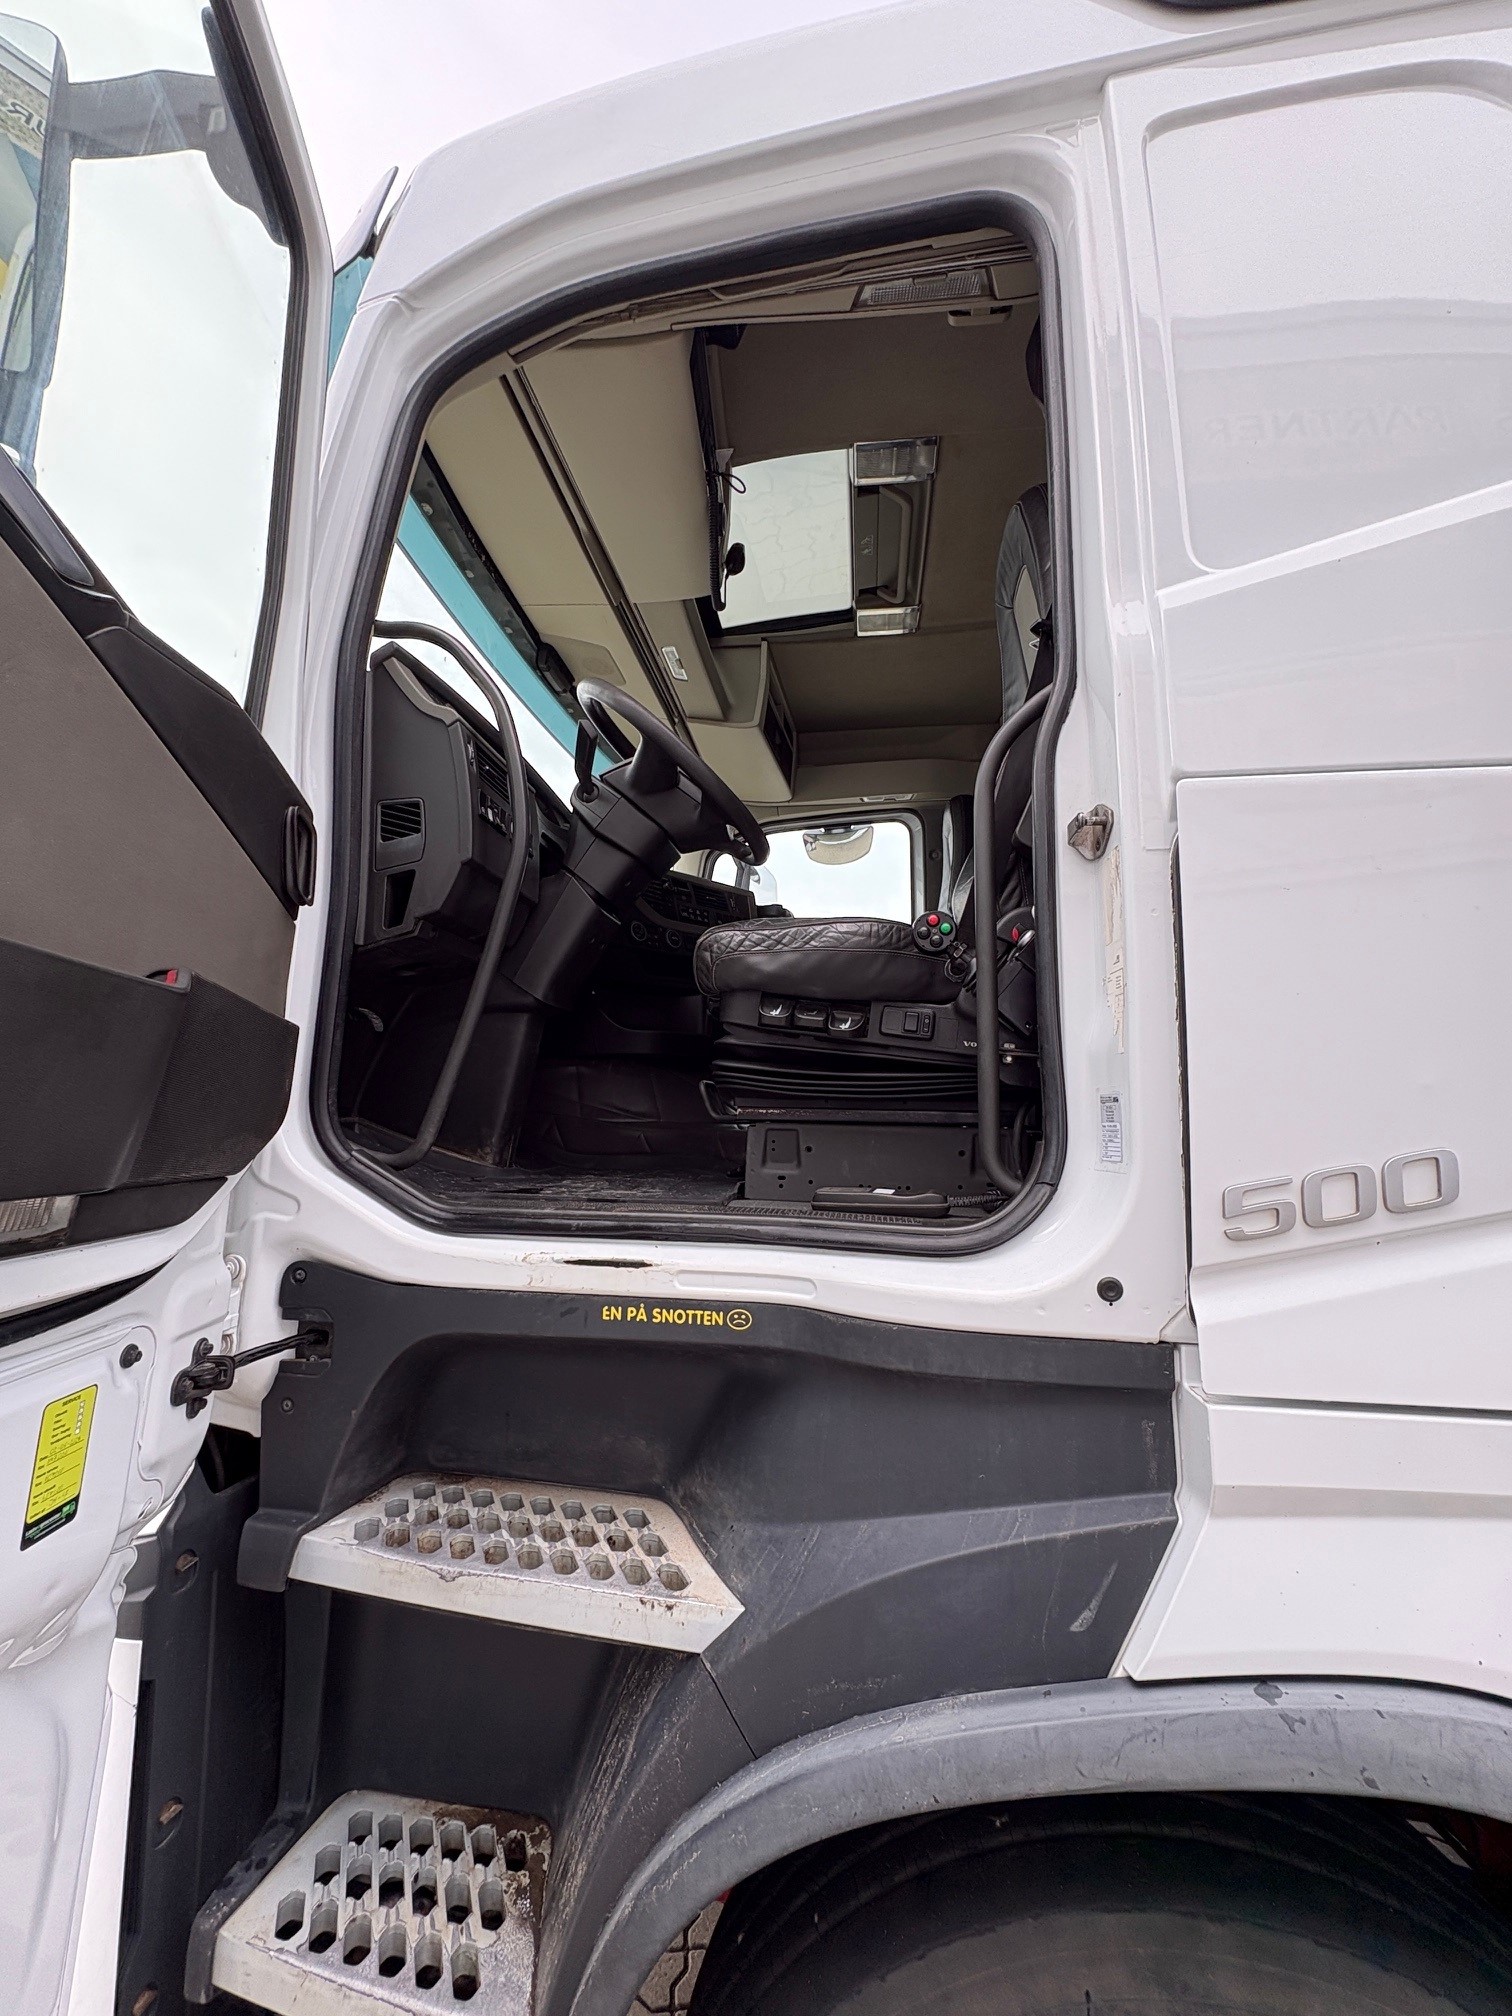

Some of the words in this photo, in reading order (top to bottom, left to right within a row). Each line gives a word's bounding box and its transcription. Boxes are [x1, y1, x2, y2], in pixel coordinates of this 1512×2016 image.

[962, 1040, 978, 1048] VO
[1222, 1147, 1460, 1241] 500
[602, 1305, 622, 1321] EN
[627, 1303, 648, 1322] PÅ
[652, 1308, 724, 1326] SNOTTEN
